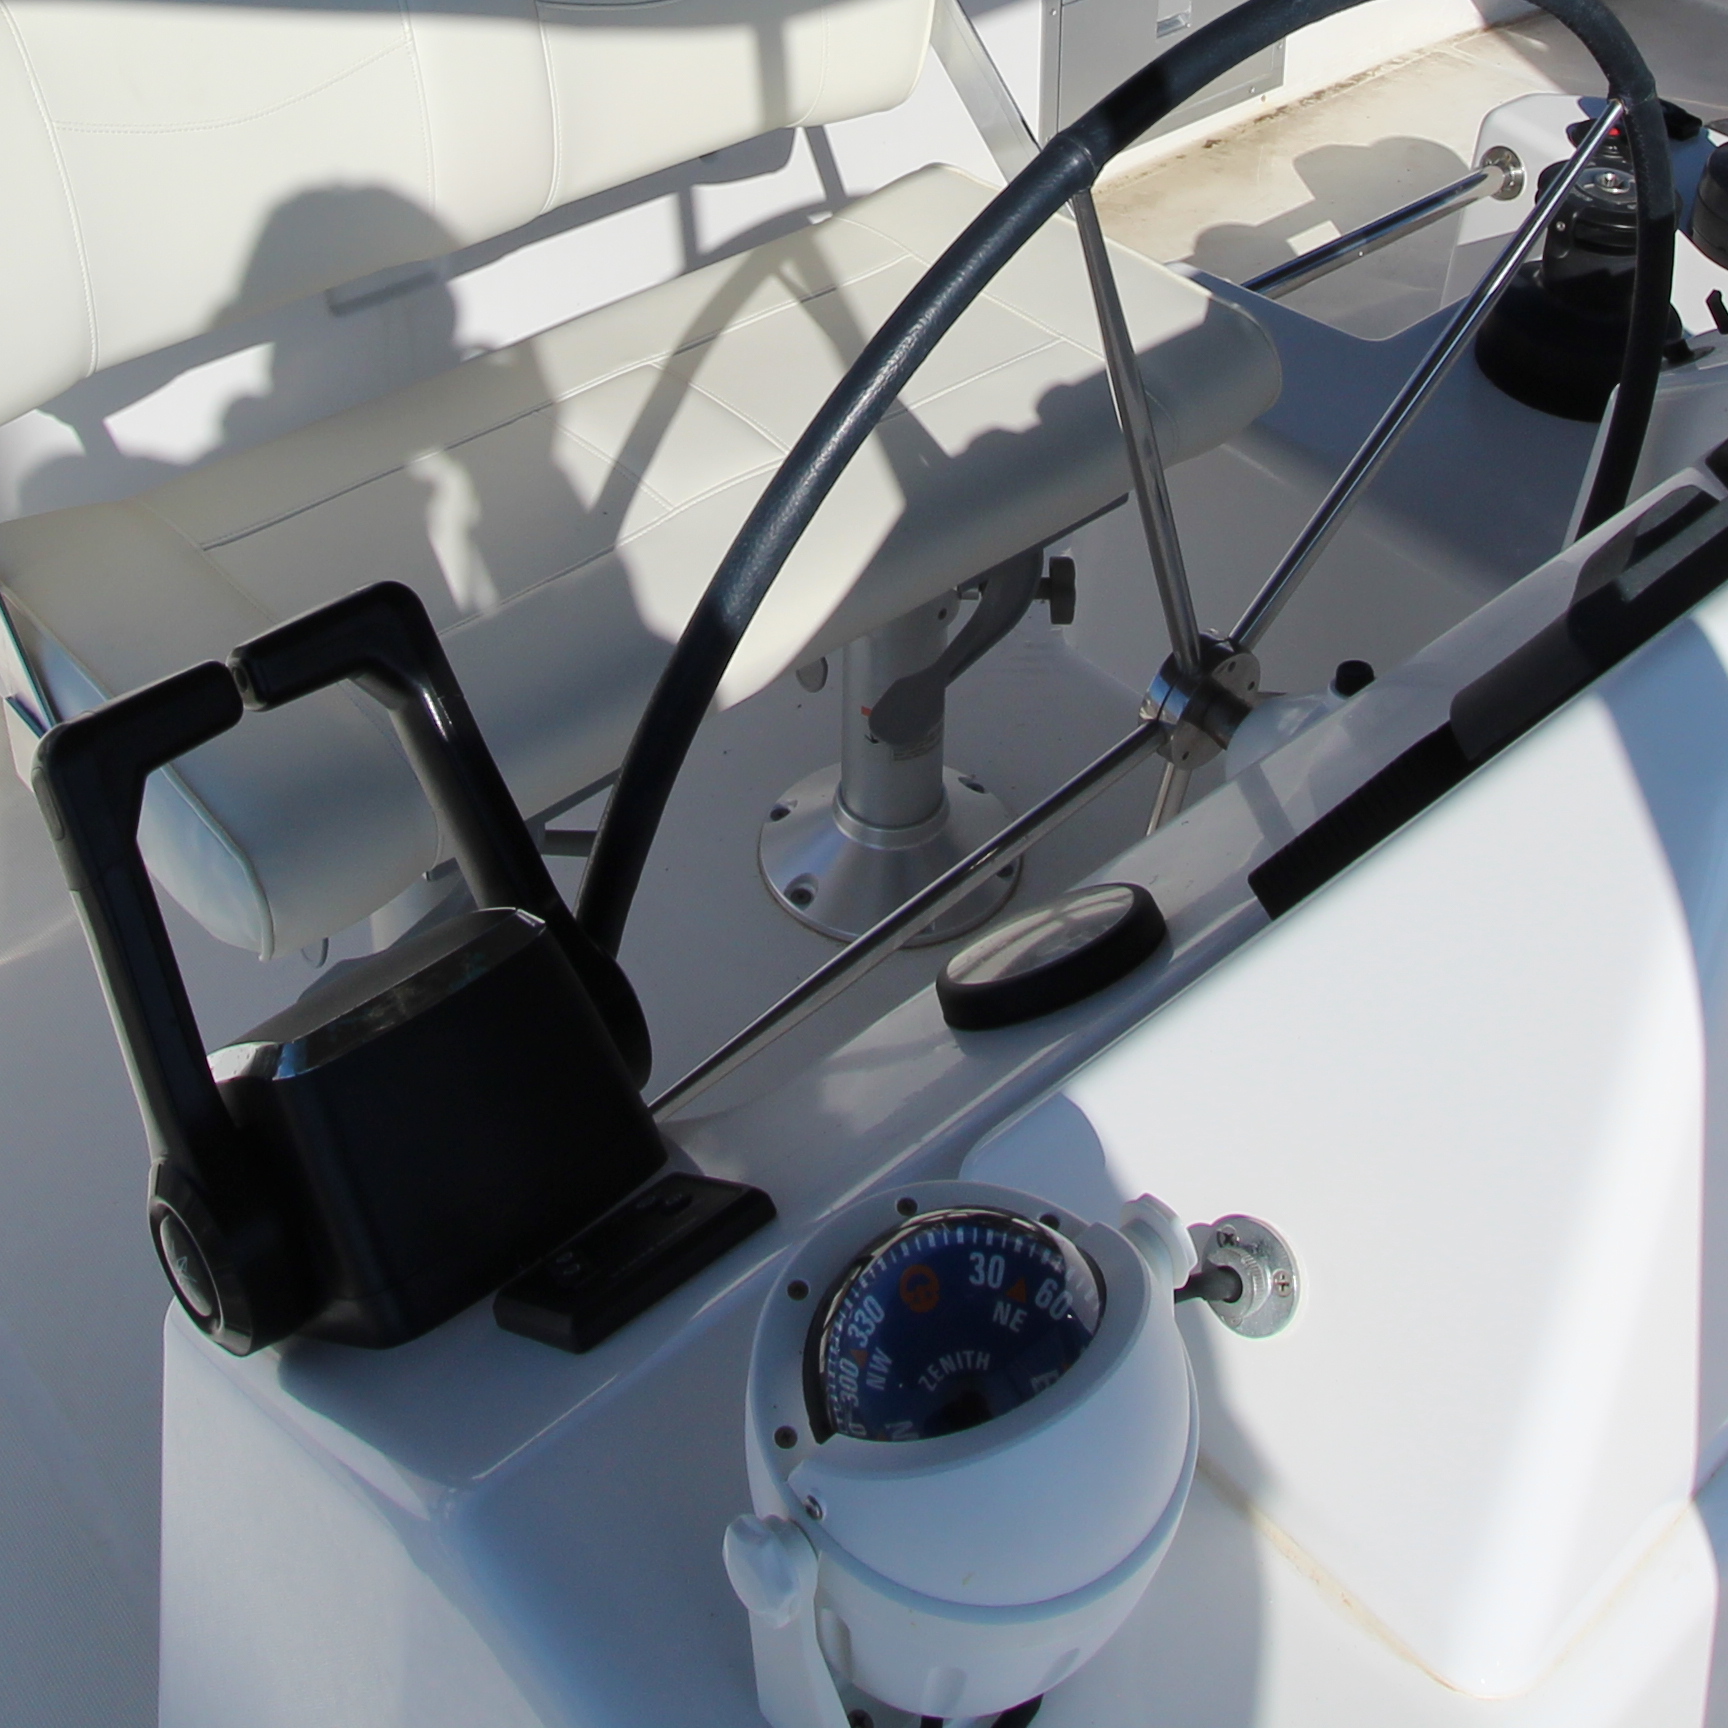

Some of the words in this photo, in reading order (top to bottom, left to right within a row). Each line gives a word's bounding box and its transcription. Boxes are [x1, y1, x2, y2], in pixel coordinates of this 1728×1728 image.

[969, 1252, 1005, 1289] 30
[993, 1301, 1028, 1332] NE
[1035, 1278, 1073, 1320] 60
[848, 1295, 885, 1348] 330
[839, 1358, 860, 1408] 300
[866, 1346, 893, 1391] NW
[918, 1350, 991, 1392] ZENITH
